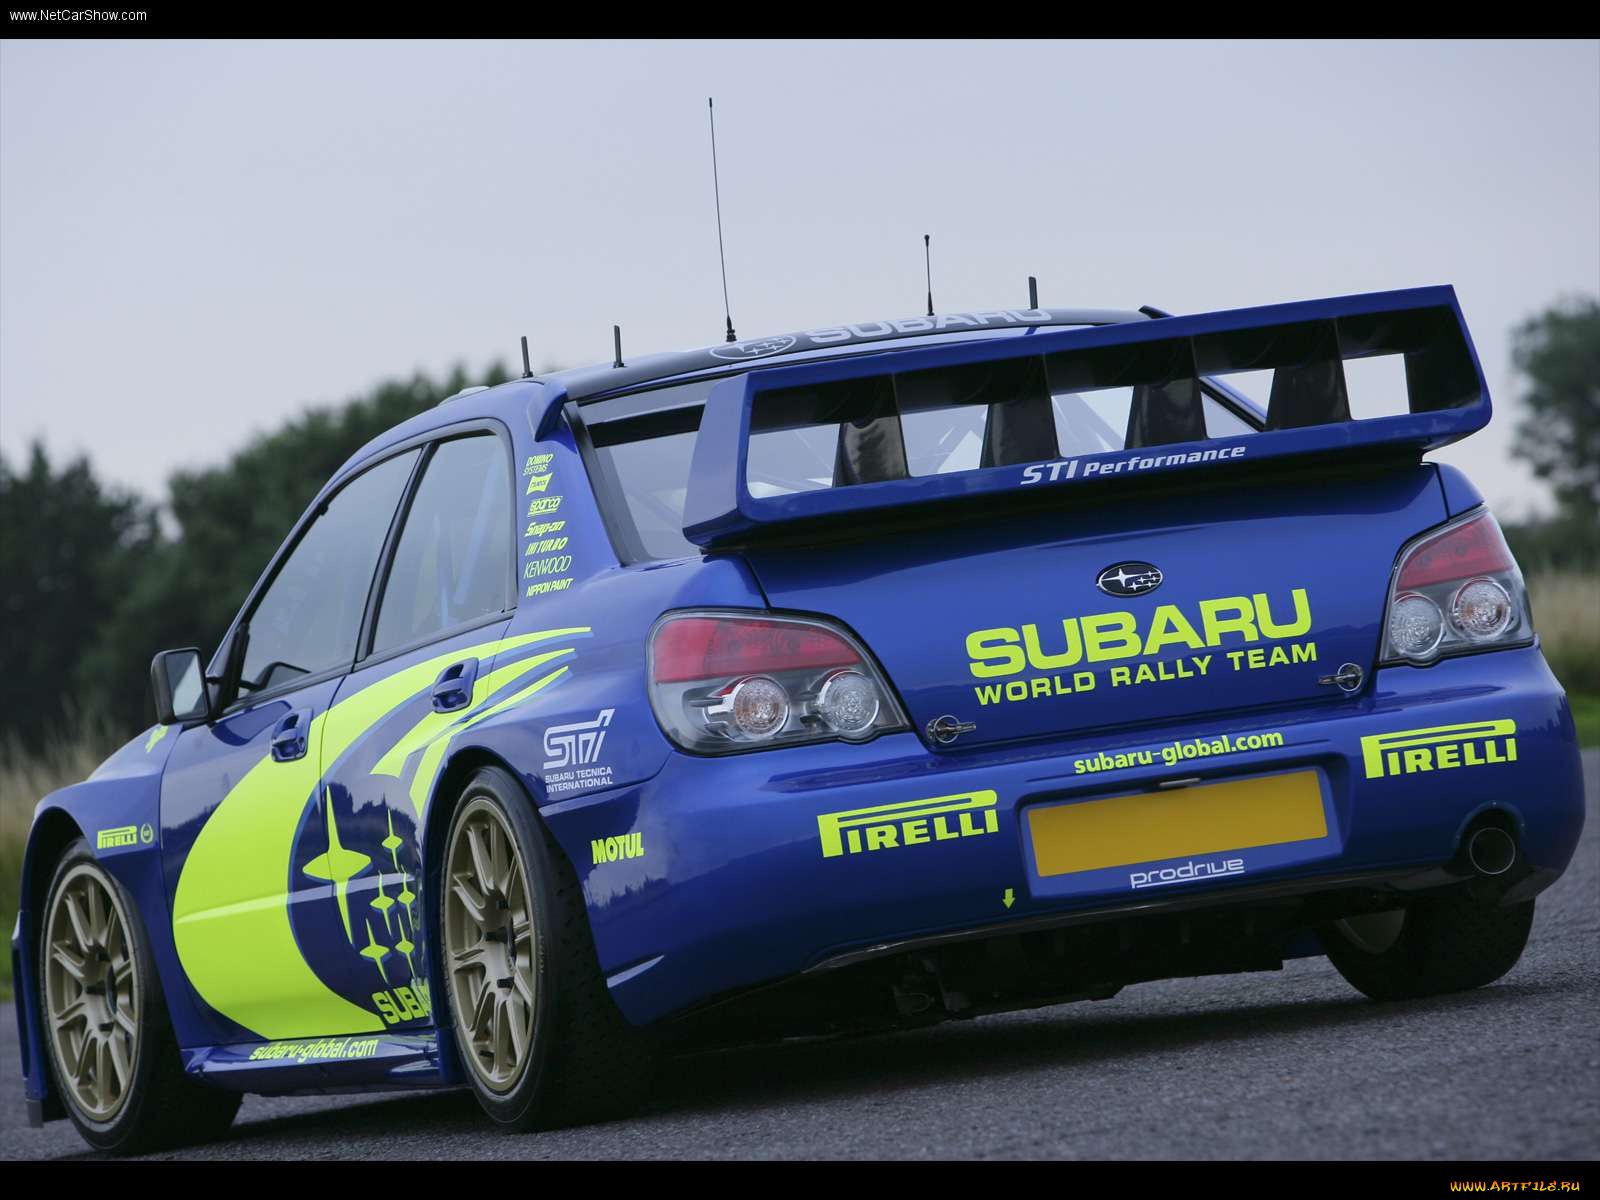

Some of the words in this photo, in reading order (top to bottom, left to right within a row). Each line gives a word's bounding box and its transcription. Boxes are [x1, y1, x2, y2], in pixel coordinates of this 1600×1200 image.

[804, 308, 1053, 344] SUBARU
[1020, 459, 1078, 485] STI
[1083, 446, 1247, 478] Performance
[524, 555, 572, 579] KENWOOD
[526, 581, 553, 598] NIPPON
[549, 578, 574, 591] PAINT
[965, 588, 1312, 679] SUBARU
[974, 671, 1096, 706] WORLD
[1110, 655, 1212, 688] RALLY
[1226, 642, 1318, 671] TEAM
[1073, 732, 1285, 775] subaru-global.com
[1359, 718, 1518, 780] PIRELLI
[545, 770, 575, 785] SUBARU
[576, 766, 613, 779] TECNICA
[546, 776, 614, 794] INTERNATIONAL
[97, 826, 137, 849] PIRELLI
[816, 789, 999, 858] PIRELLI
[591, 831, 645, 865] MOTUL
[1130, 858, 1245, 889] prodrive
